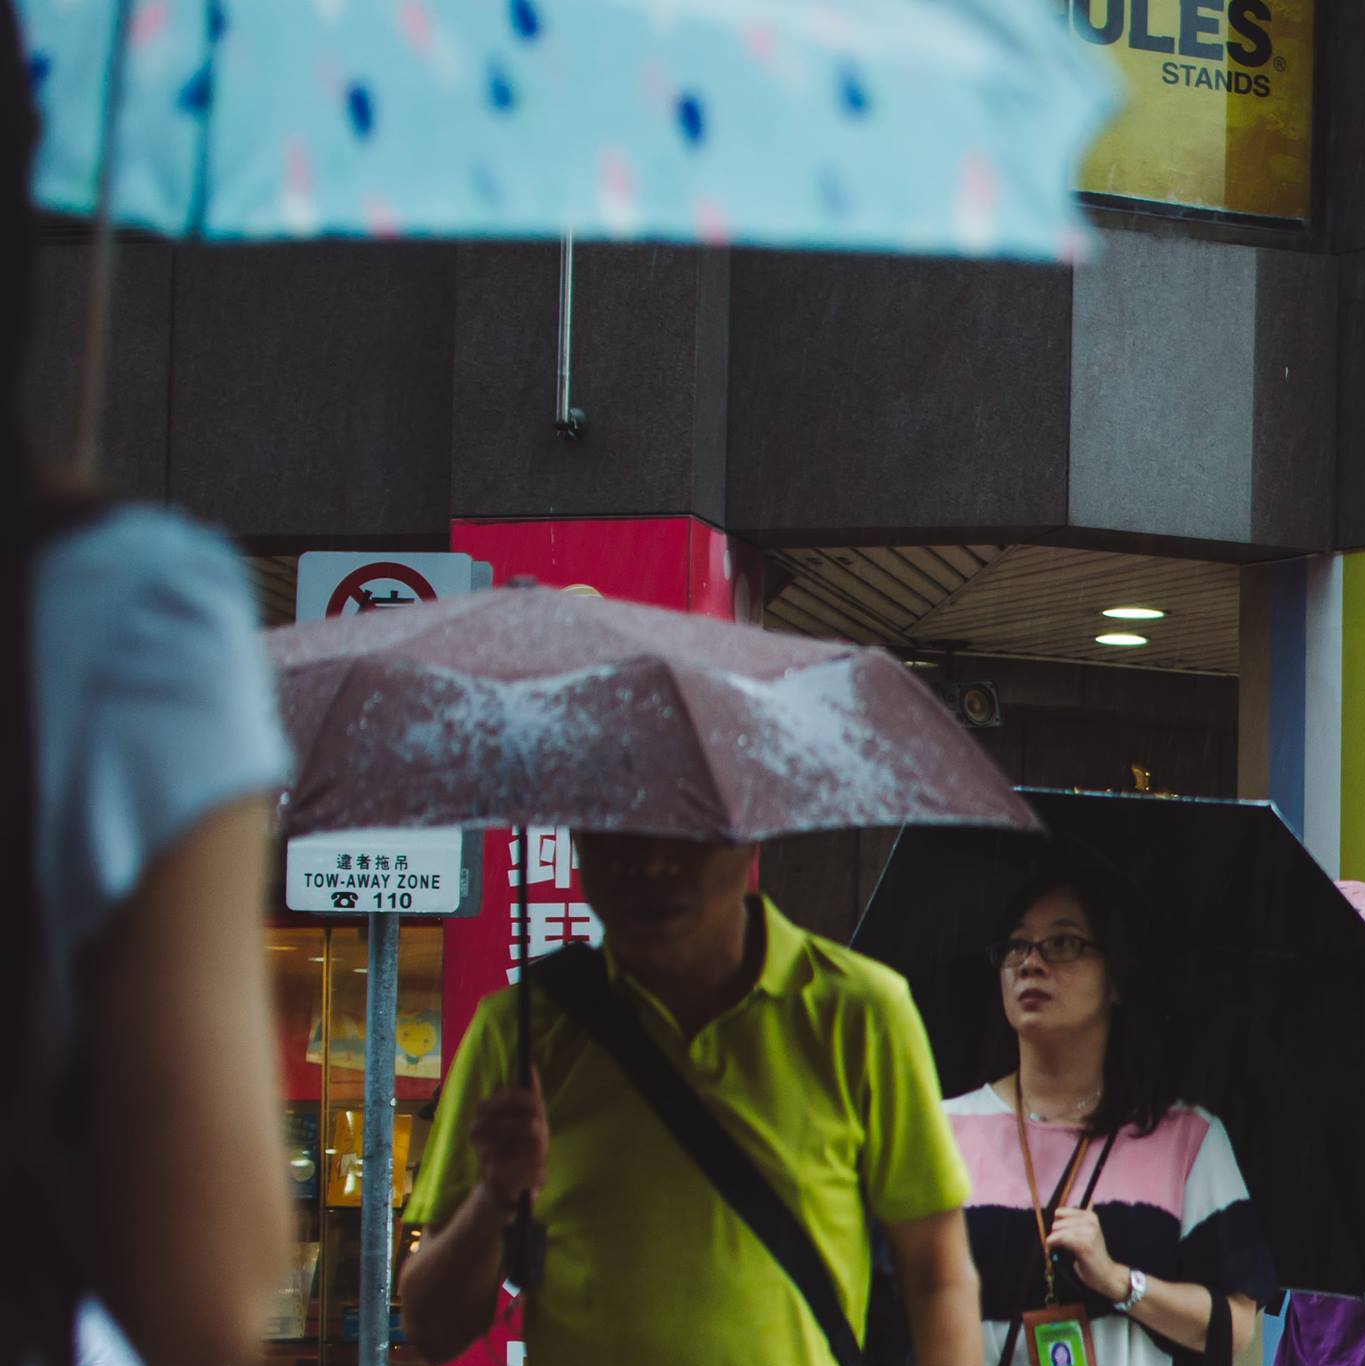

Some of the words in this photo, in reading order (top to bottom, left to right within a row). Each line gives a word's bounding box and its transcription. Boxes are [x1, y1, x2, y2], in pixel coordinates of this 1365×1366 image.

[1162, 62, 1270, 97] STANDS
[337, 853, 409, 871] 違者拖吊
[304, 873, 390, 889] TOW-AWAY
[397, 874, 441, 890] ZONE
[373, 892, 413, 909] 110
